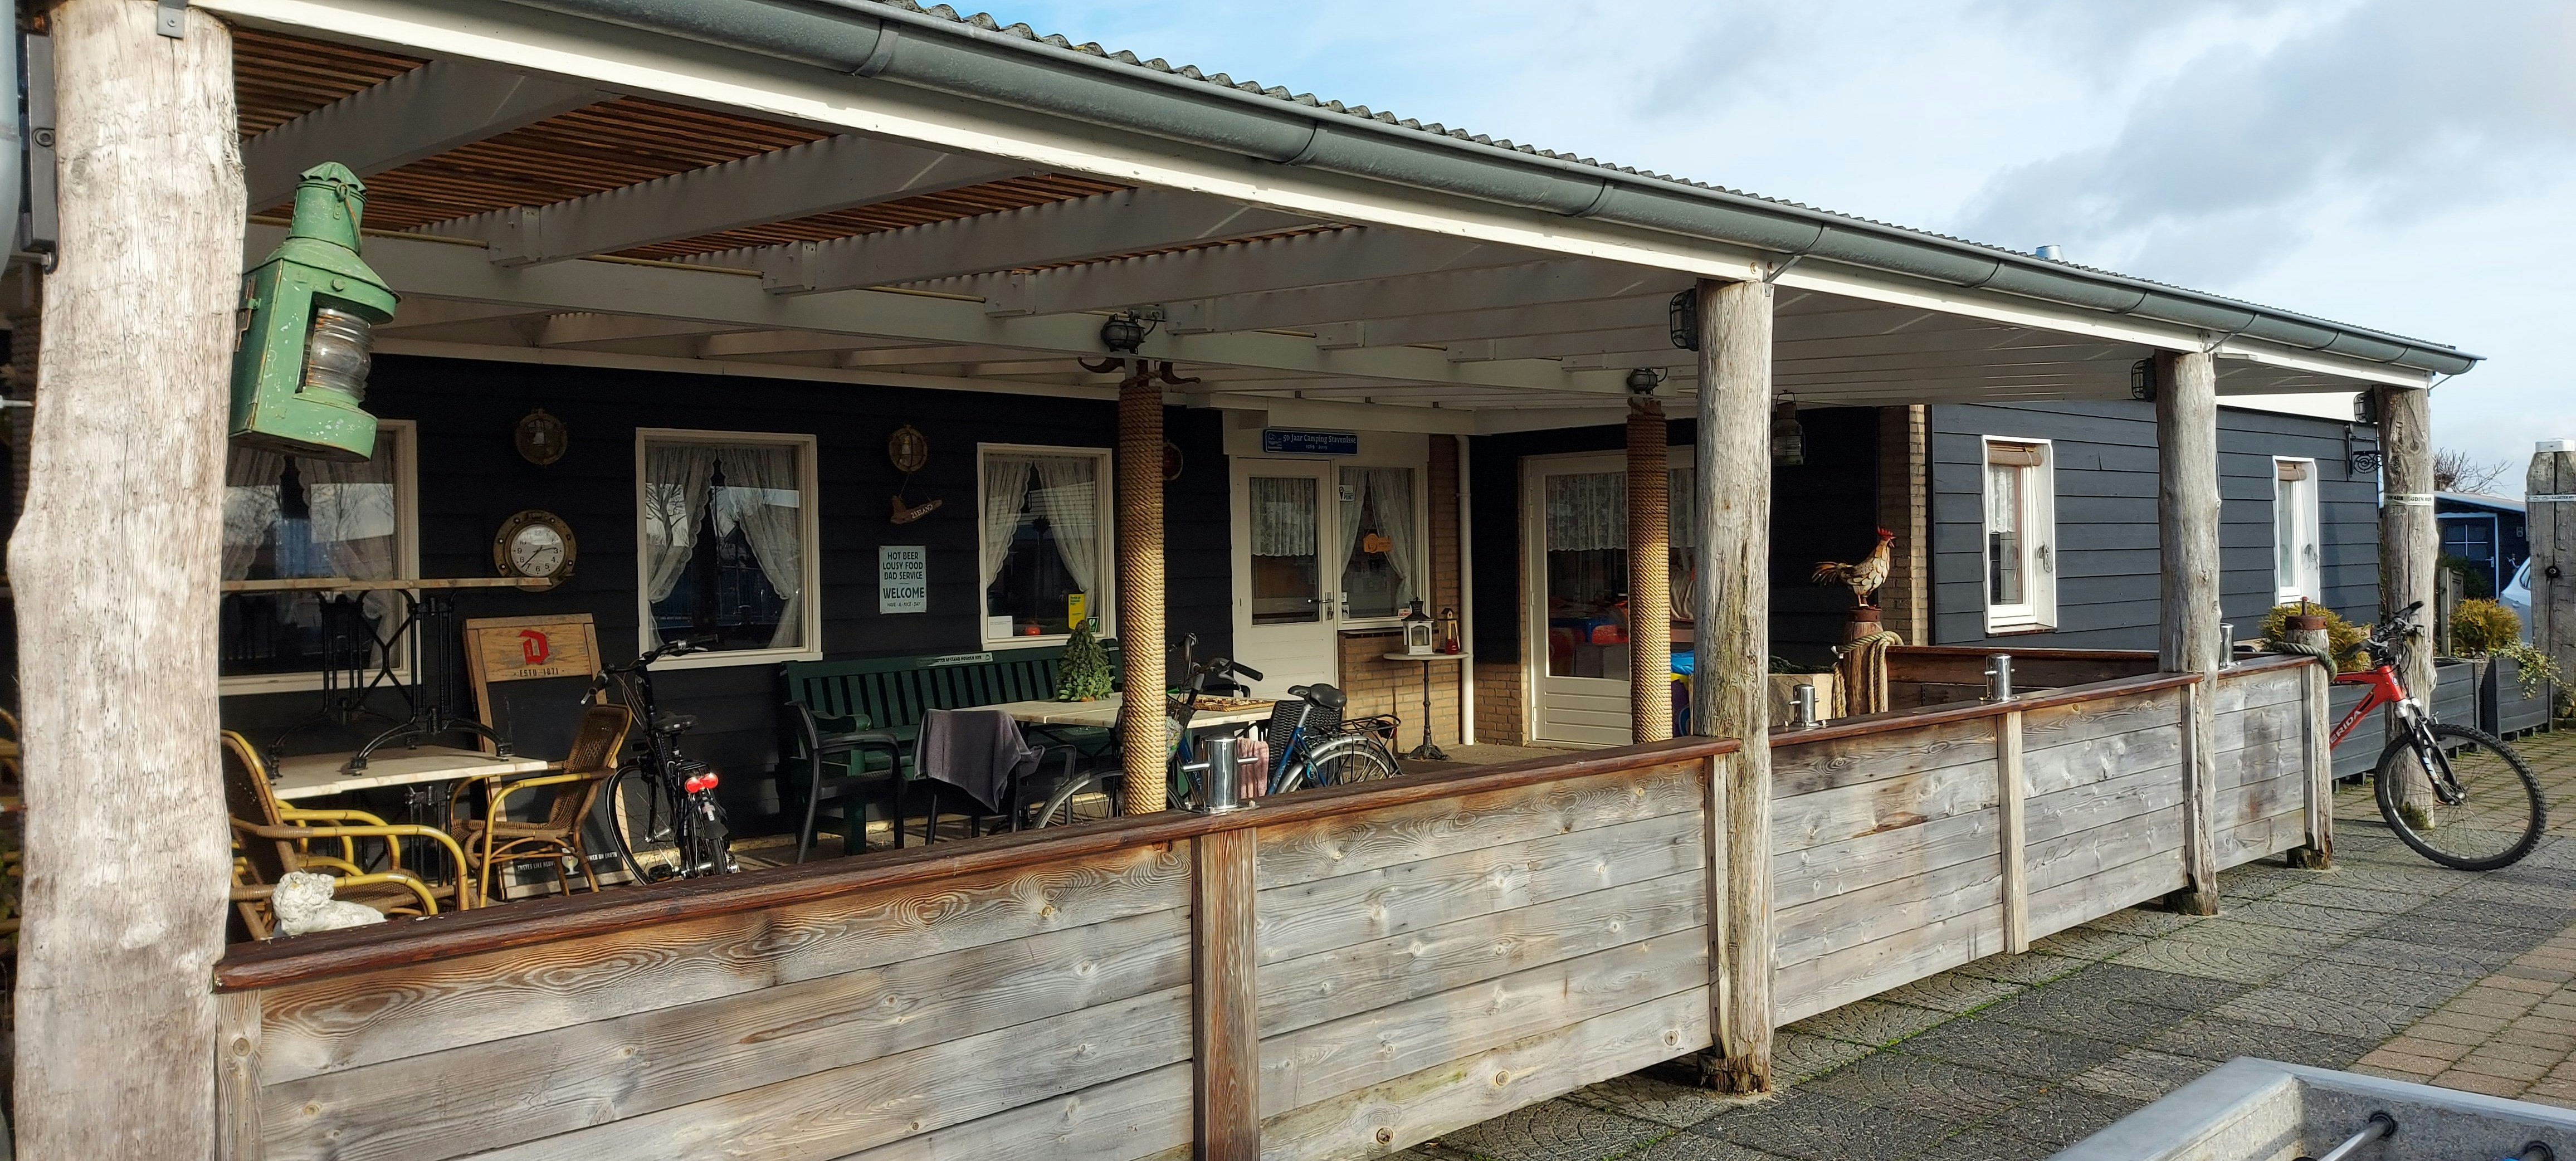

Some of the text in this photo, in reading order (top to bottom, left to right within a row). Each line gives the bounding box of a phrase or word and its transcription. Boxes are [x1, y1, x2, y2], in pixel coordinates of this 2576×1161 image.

[1291, 434, 1303, 443] Jaar
[1304, 435, 1328, 444] Camping
[1328, 435, 1356, 444] Stavenisse
[910, 504, 933, 519] ZEELAND
[887, 552, 918, 560] HOT BEER
[883, 562, 903, 570] LOUSY
[899, 572, 923, 580] SERVICE
[883, 587, 924, 599] WELCOME
[2330, 710, 2362, 744] ERIDA
